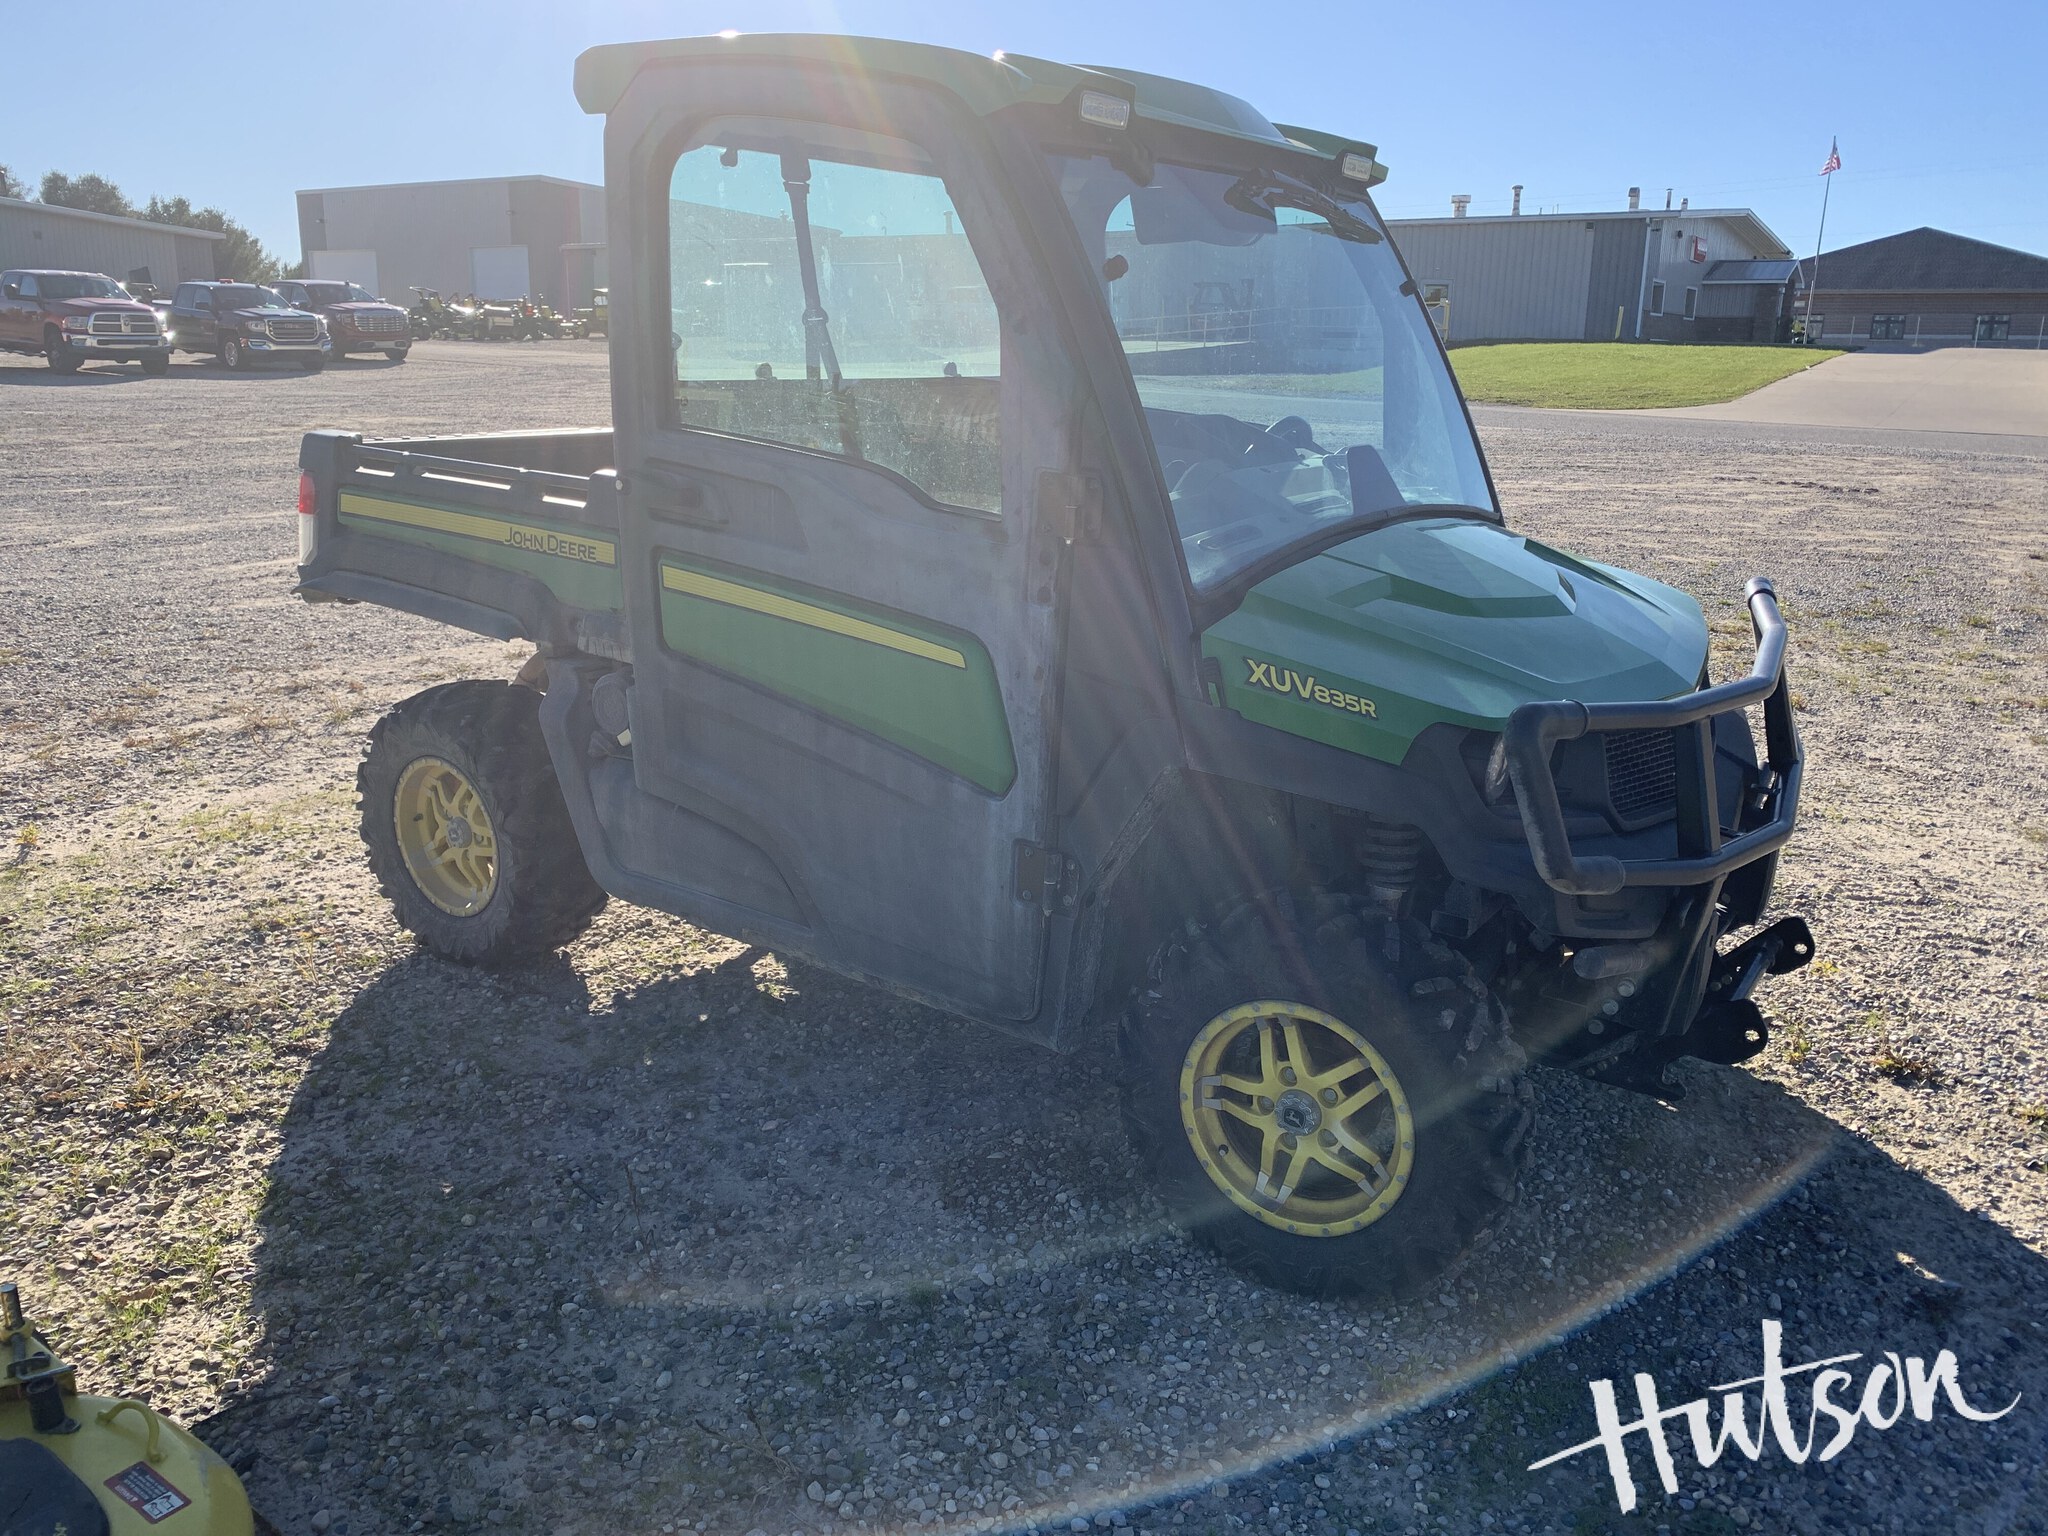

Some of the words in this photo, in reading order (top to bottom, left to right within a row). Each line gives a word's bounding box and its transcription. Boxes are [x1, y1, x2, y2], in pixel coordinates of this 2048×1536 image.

[504, 527, 544, 551] JOHN
[547, 534, 597, 561] DEERE
[1246, 658, 1378, 718] XUV835R
